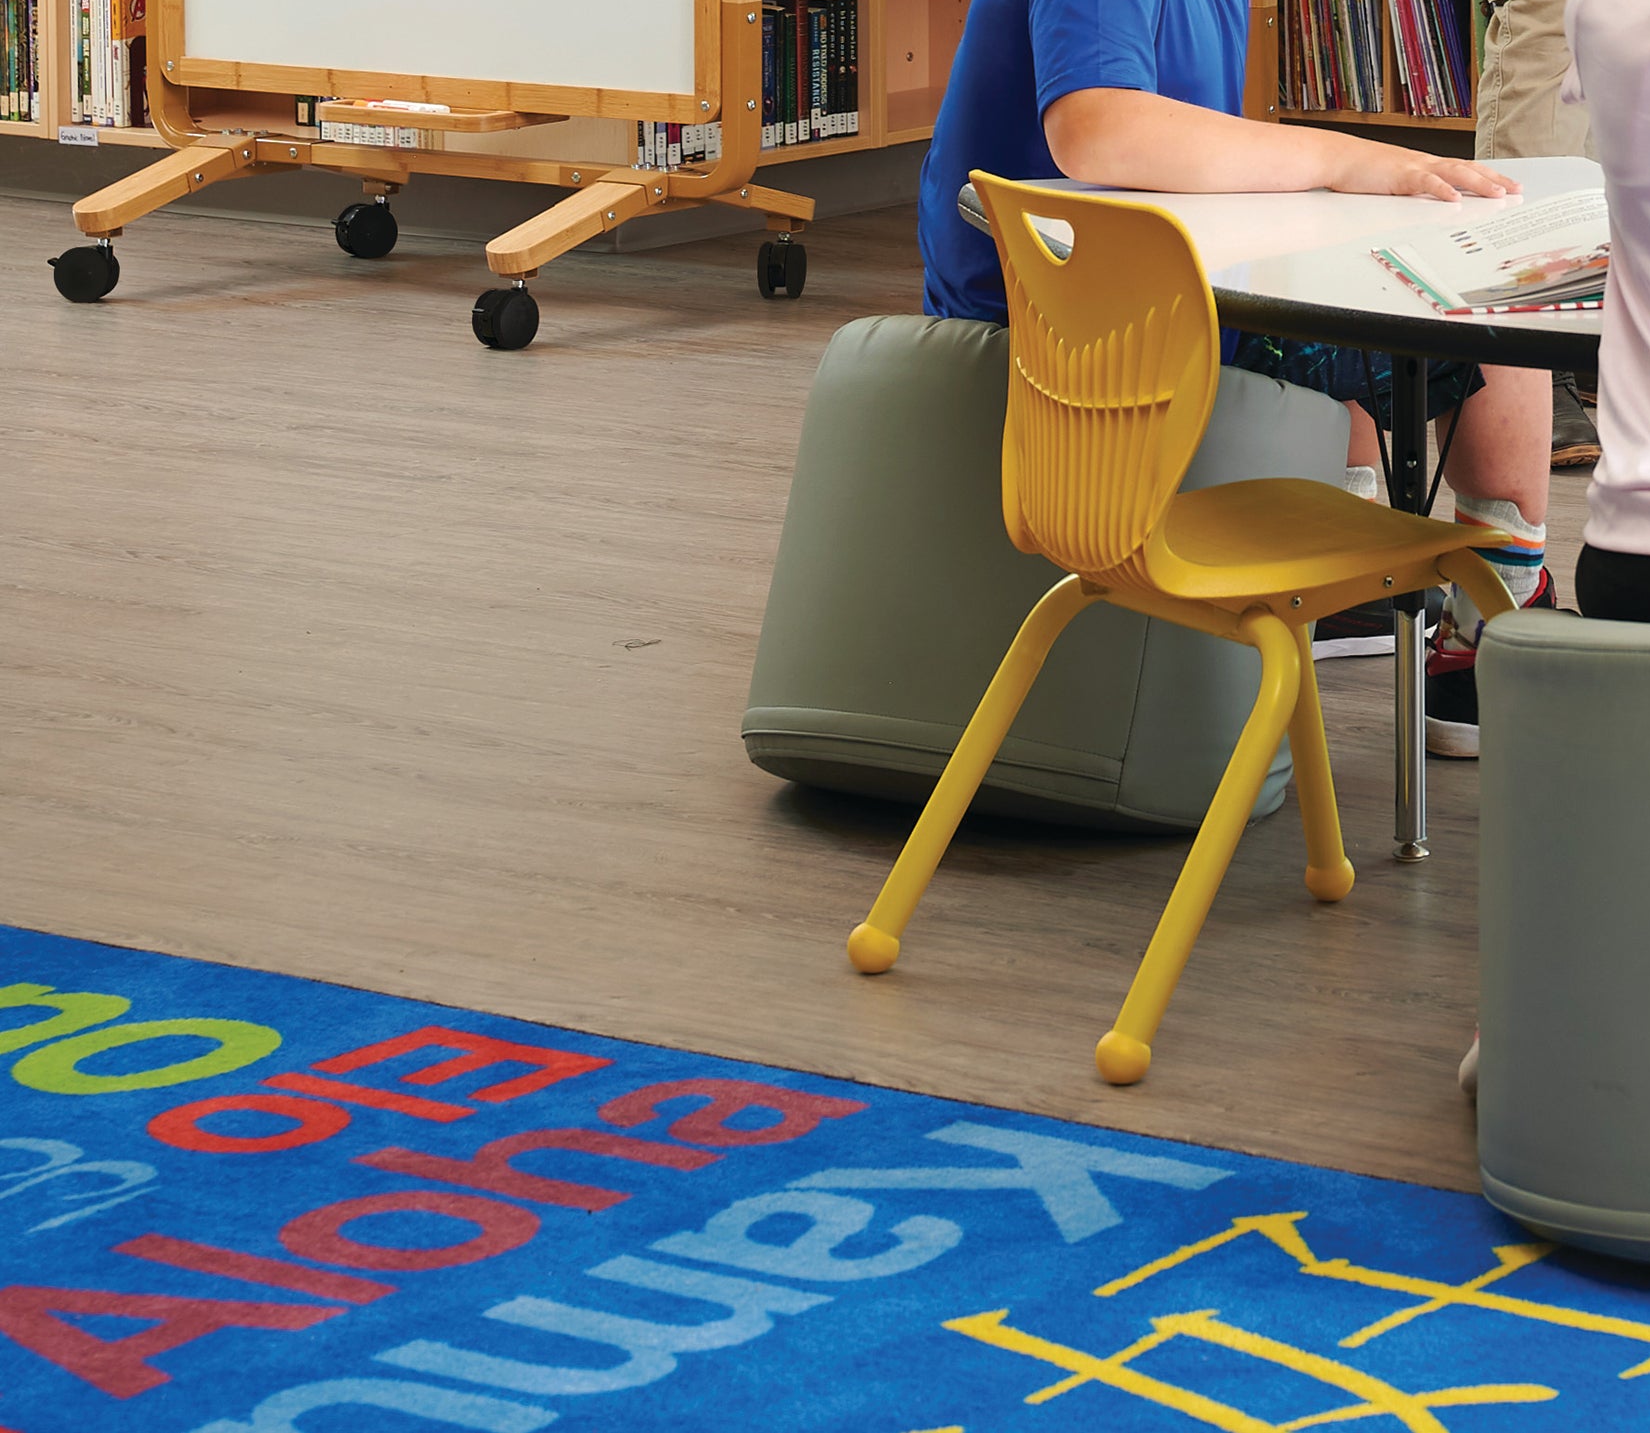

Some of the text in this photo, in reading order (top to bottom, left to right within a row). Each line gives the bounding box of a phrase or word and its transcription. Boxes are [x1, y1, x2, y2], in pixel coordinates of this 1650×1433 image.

[849, 10, 857, 61] shadowland
[811, 48, 820, 108] RESISTANCE
[0, 1077, 870, 1400] Aloha
